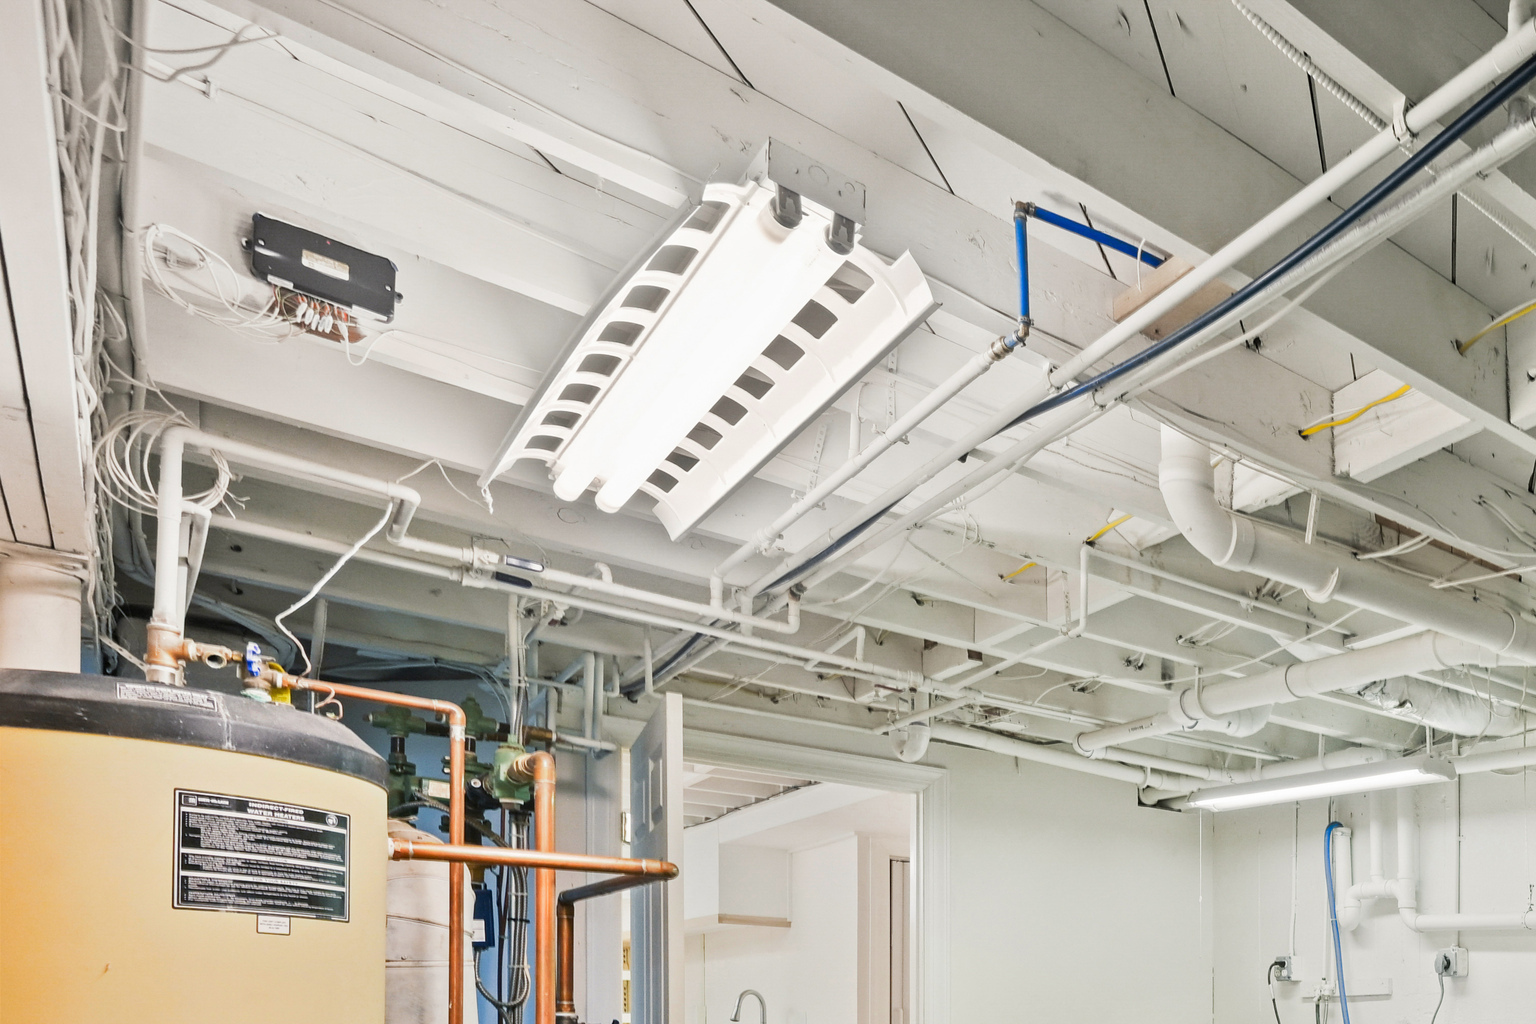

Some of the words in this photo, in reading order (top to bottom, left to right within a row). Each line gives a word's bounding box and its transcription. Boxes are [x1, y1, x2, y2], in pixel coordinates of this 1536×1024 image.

[247, 808, 273, 817] WATER
[274, 811, 305, 821] HEATERS
[248, 802, 304, 815] INDIRECT-FIRED
